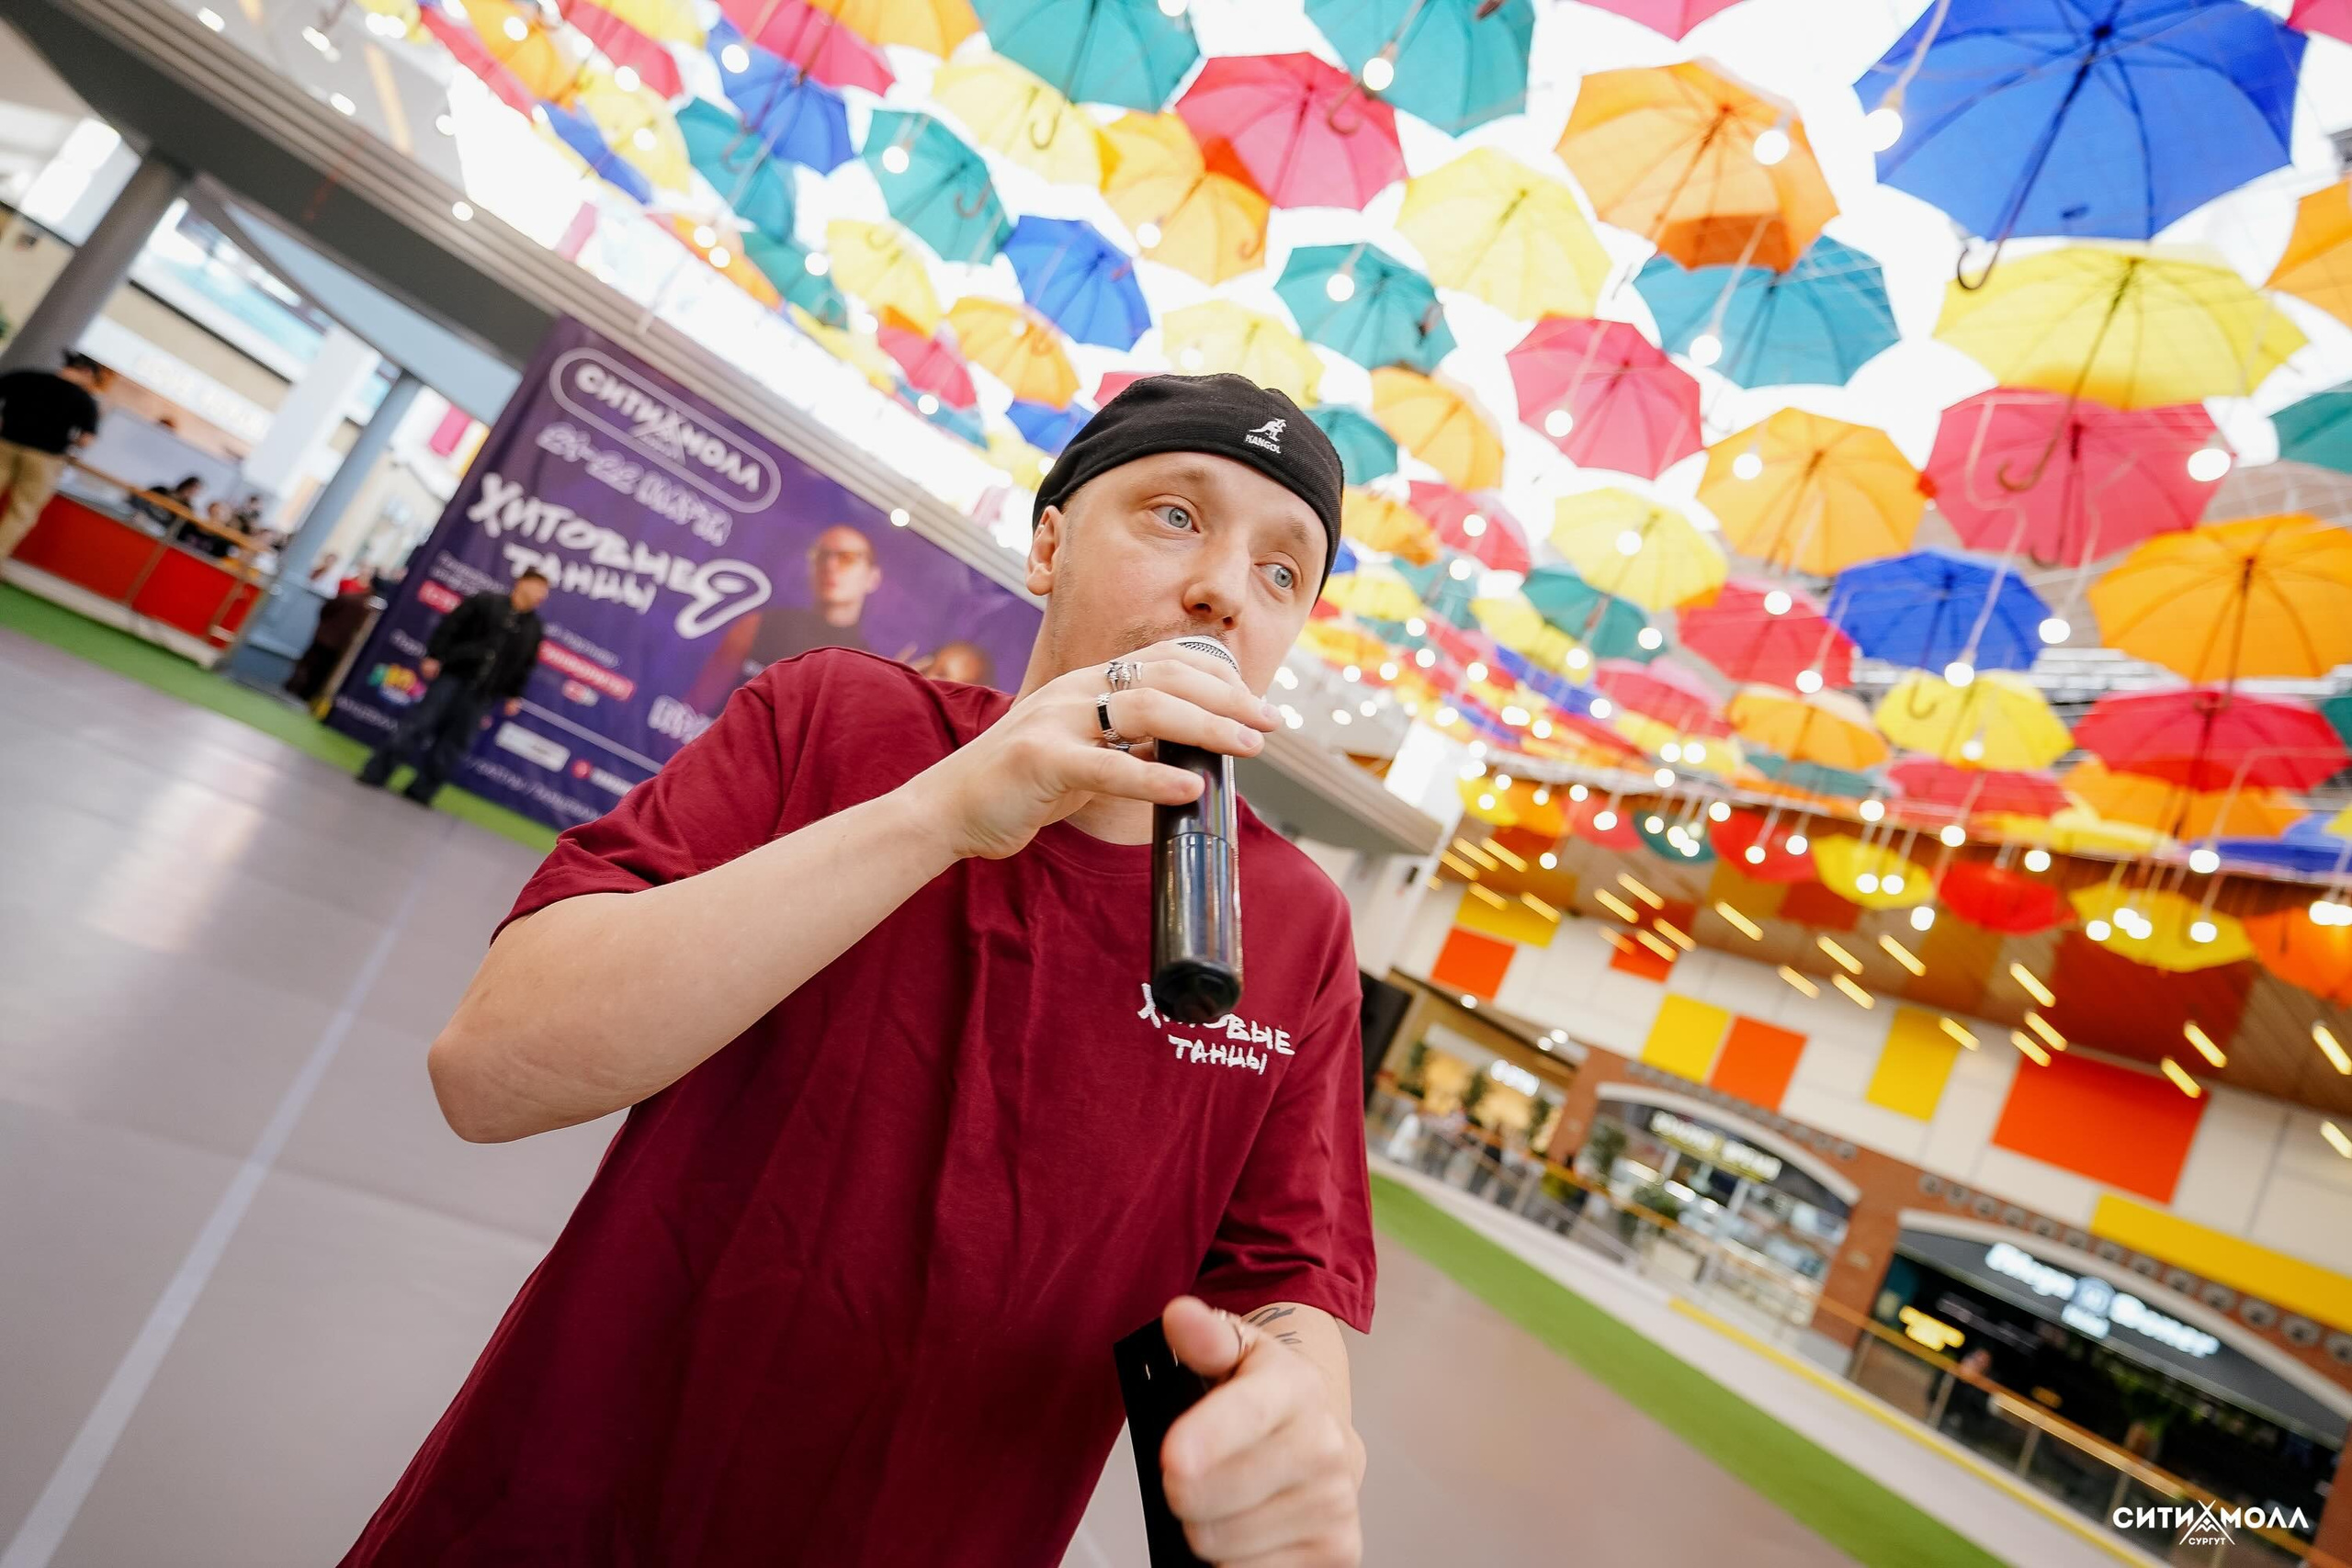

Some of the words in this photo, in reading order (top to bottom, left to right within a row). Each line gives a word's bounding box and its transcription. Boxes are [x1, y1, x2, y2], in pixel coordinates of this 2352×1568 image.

[1245, 434, 1282, 454] KANGOL
[467, 472, 702, 597] ХИТОВЫЕ
[503, 541, 658, 615] ТАНЦЫ
[1137, 983, 1295, 1055] ХВЫЕ
[1168, 1034, 1268, 1075] ТАНЦЫ
